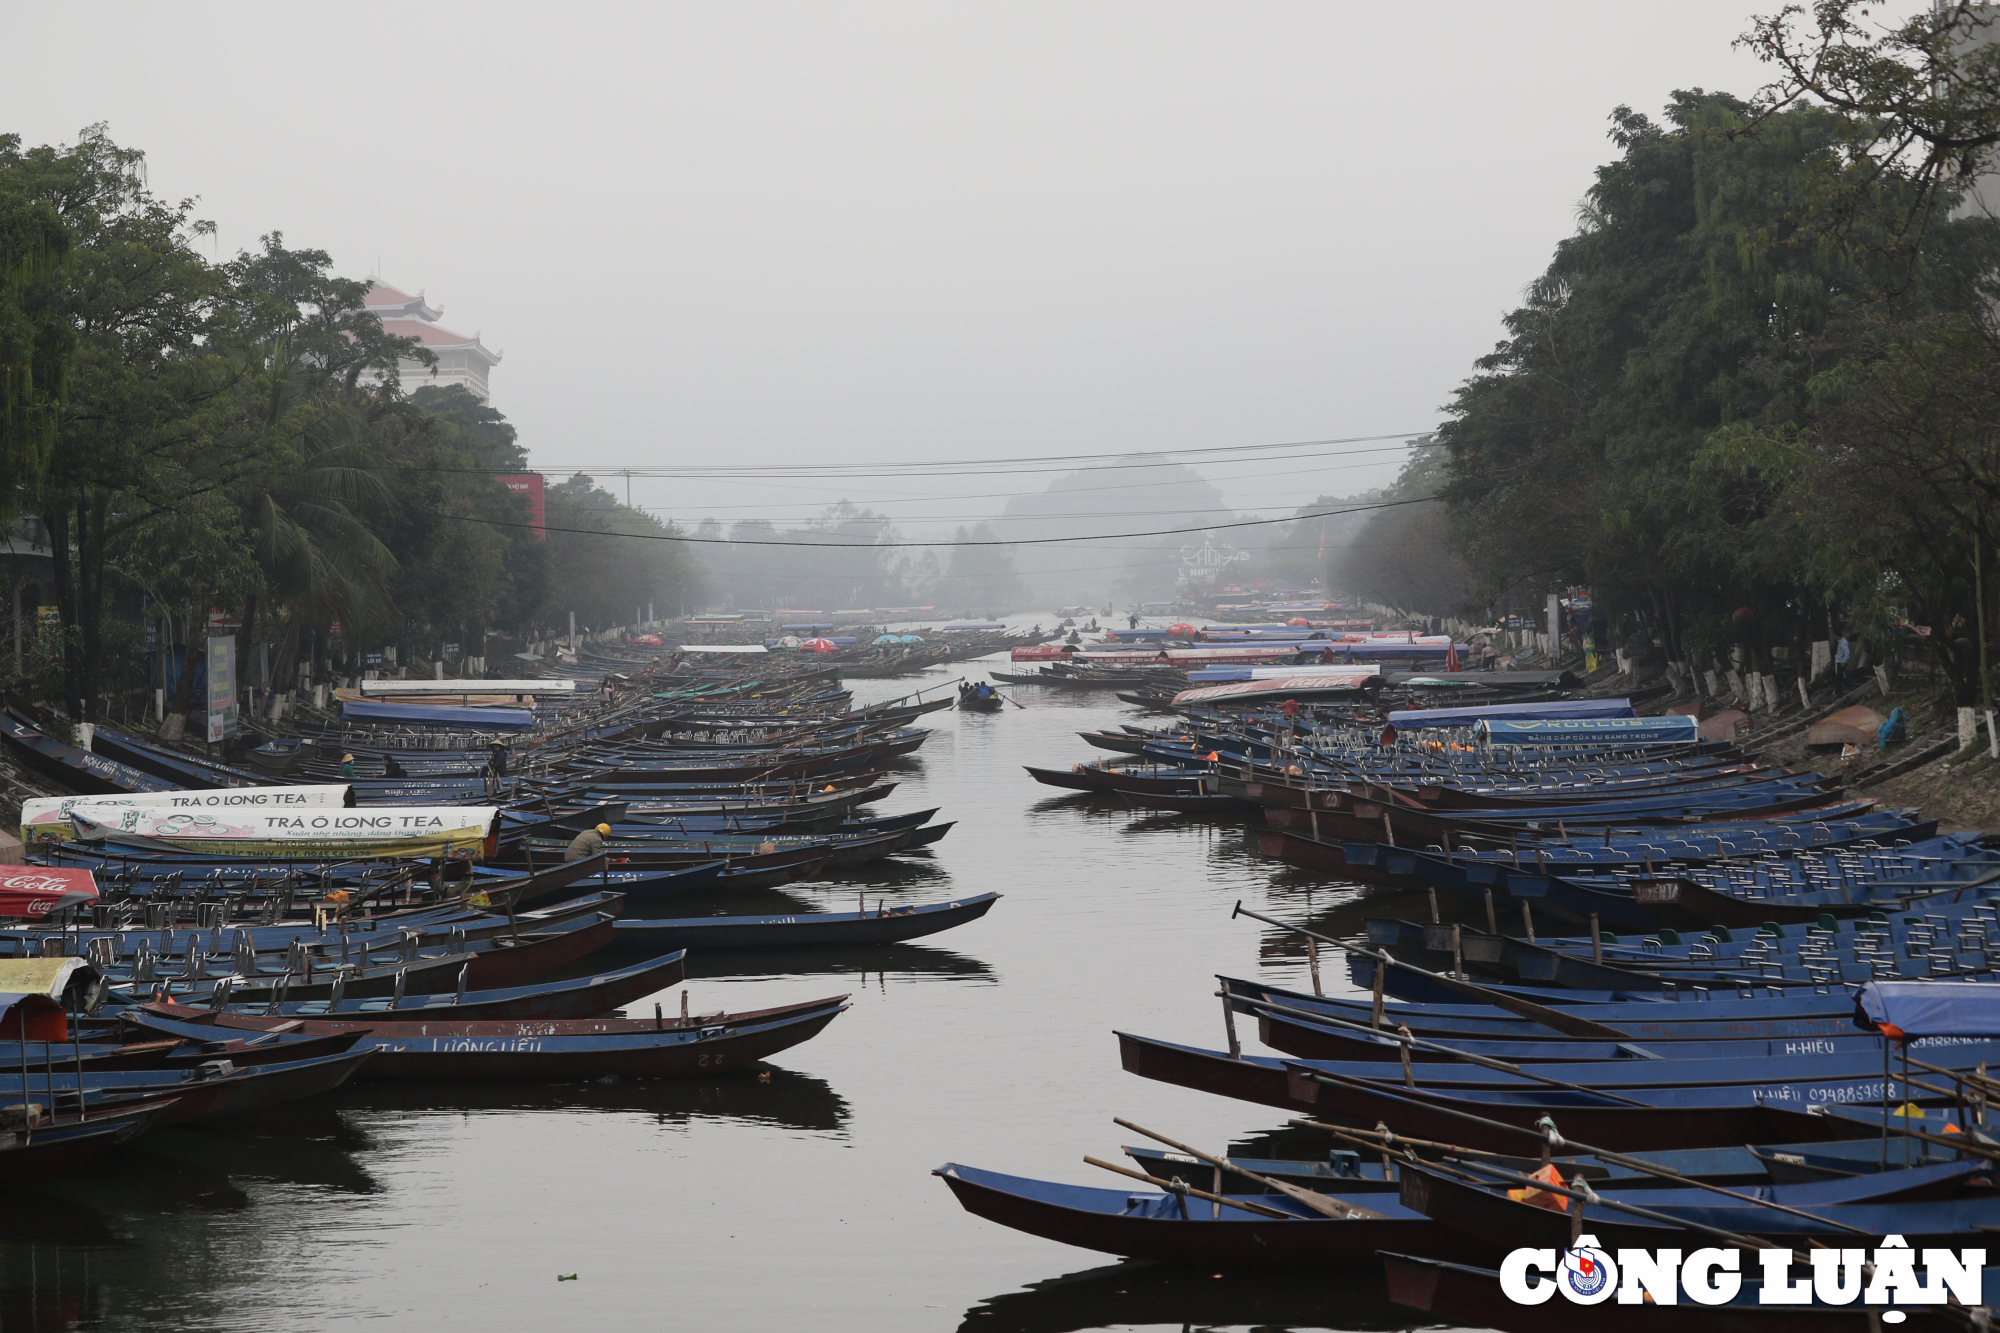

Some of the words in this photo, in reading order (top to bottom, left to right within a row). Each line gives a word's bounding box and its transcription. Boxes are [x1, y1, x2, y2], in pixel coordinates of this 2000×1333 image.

[224, 794, 268, 806] LONG
[273, 794, 307, 804] TEA
[265, 814, 304, 828] TRÀ
[311, 814, 328, 828] Ô
[334, 816, 392, 828] LONG
[400, 815, 444, 826] TEA
